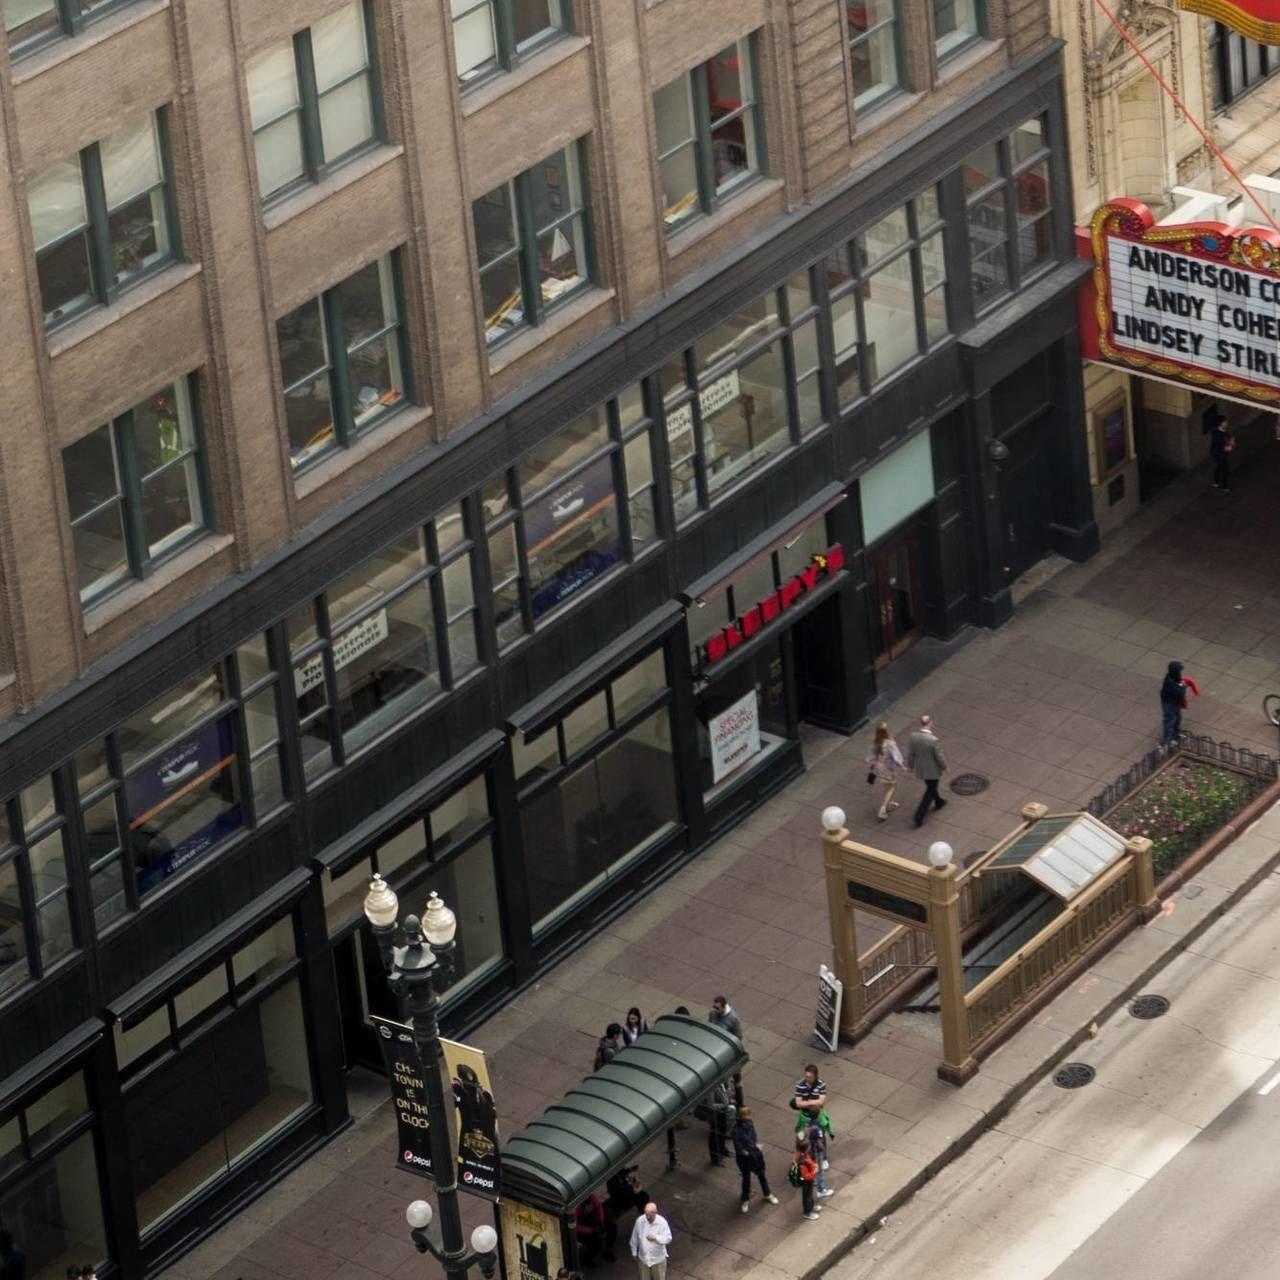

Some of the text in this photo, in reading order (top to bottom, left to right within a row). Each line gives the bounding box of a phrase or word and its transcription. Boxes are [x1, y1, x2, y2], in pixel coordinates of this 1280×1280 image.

[1128, 246, 1250, 297] ANDERSON
[1145, 286, 1205, 320] ANDY
[1112, 311, 1205, 356] LINDSEY
[394, 1072, 424, 1089] TOWN
[406, 1089, 416, 1098] IS
[396, 1098, 429, 1115] ON TH
[412, 1155, 432, 1168] pepsi
[473, 1175, 494, 1189] pepsi
